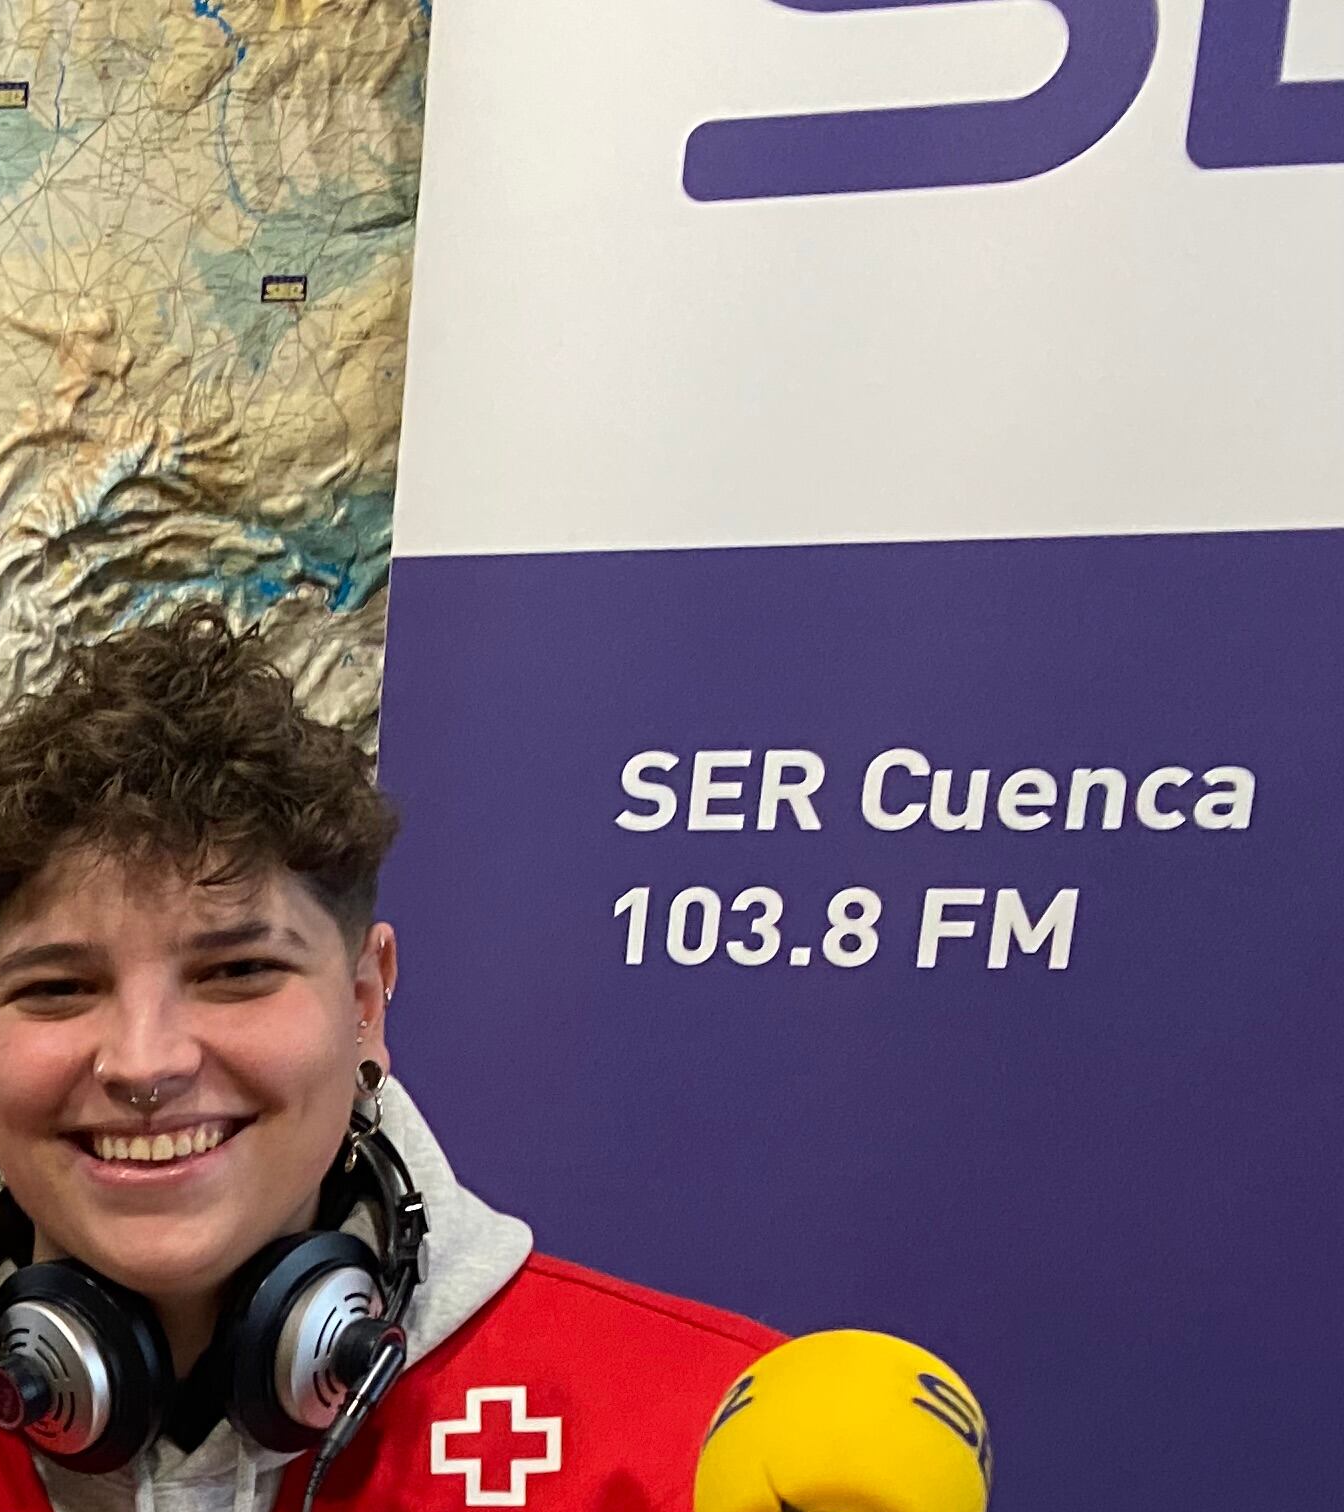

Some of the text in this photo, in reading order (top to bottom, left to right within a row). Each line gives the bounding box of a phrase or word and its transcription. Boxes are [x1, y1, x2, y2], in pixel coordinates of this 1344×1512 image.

[613, 747, 1258, 832] SER Cuenca
[611, 886, 1080, 970] 103.8 FM
